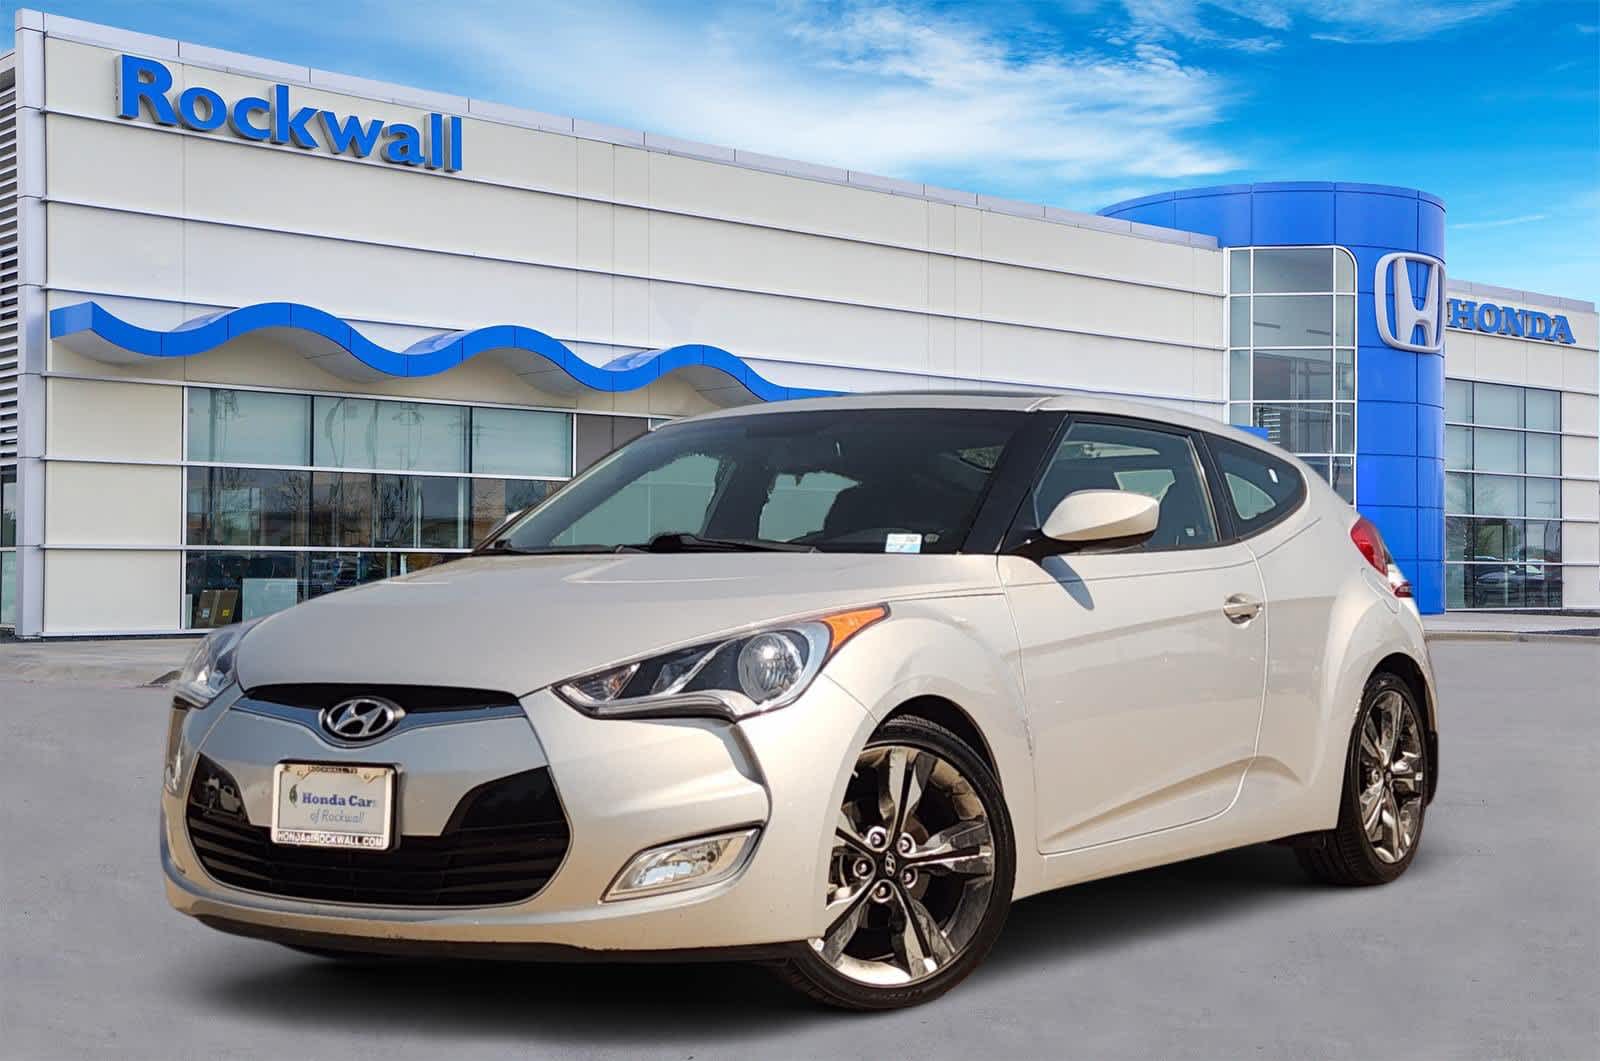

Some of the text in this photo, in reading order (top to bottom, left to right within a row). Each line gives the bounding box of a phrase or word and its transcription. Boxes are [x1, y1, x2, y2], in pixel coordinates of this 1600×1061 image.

[116, 54, 463, 172] Rockwall
[1448, 298, 1576, 344] HONDA
[302, 792, 376, 808] Honda Car
